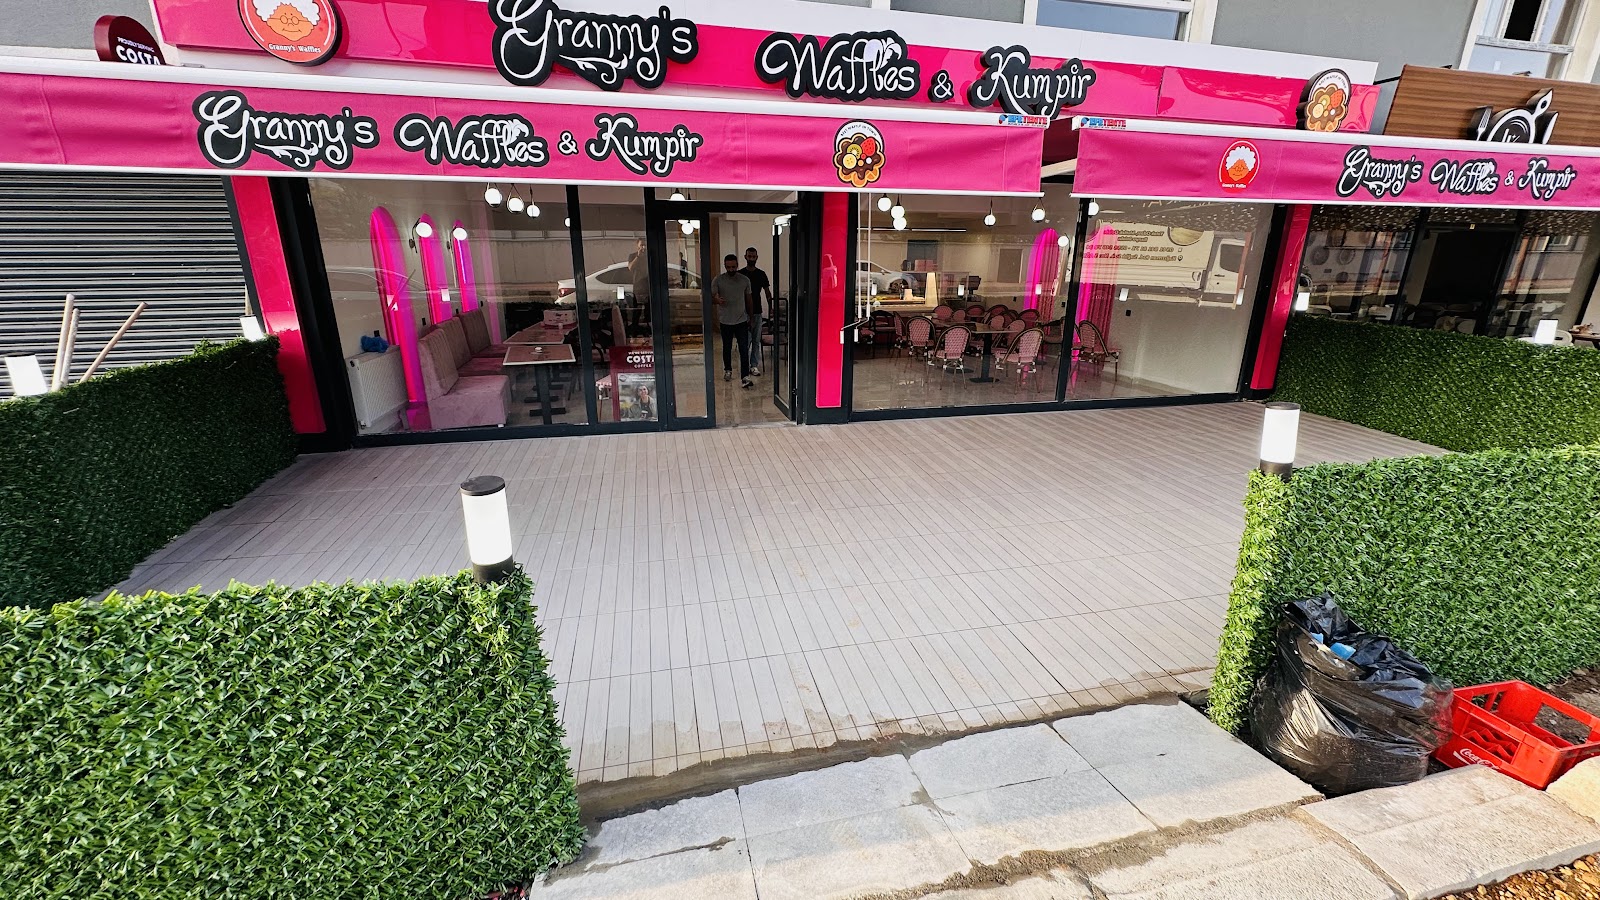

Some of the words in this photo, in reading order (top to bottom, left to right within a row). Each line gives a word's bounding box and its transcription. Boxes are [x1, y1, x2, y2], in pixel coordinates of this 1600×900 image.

[268, 43, 296, 52] Granny's
[297, 45, 321, 53] Waffles
[496, 0, 692, 81] Granny's
[761, 37, 915, 95] Waffles
[933, 72, 954, 99] &
[976, 51, 1092, 117] Kumpir
[199, 95, 375, 165] Granny's
[399, 118, 545, 164] Waffles
[559, 131, 578, 156] &
[589, 117, 700, 173] Kumpir
[1338, 149, 1421, 195] Granny's
[1431, 160, 1498, 192] Waffles
[1504, 171, 1514, 186] &
[1519, 160, 1576, 199] Kumpir
